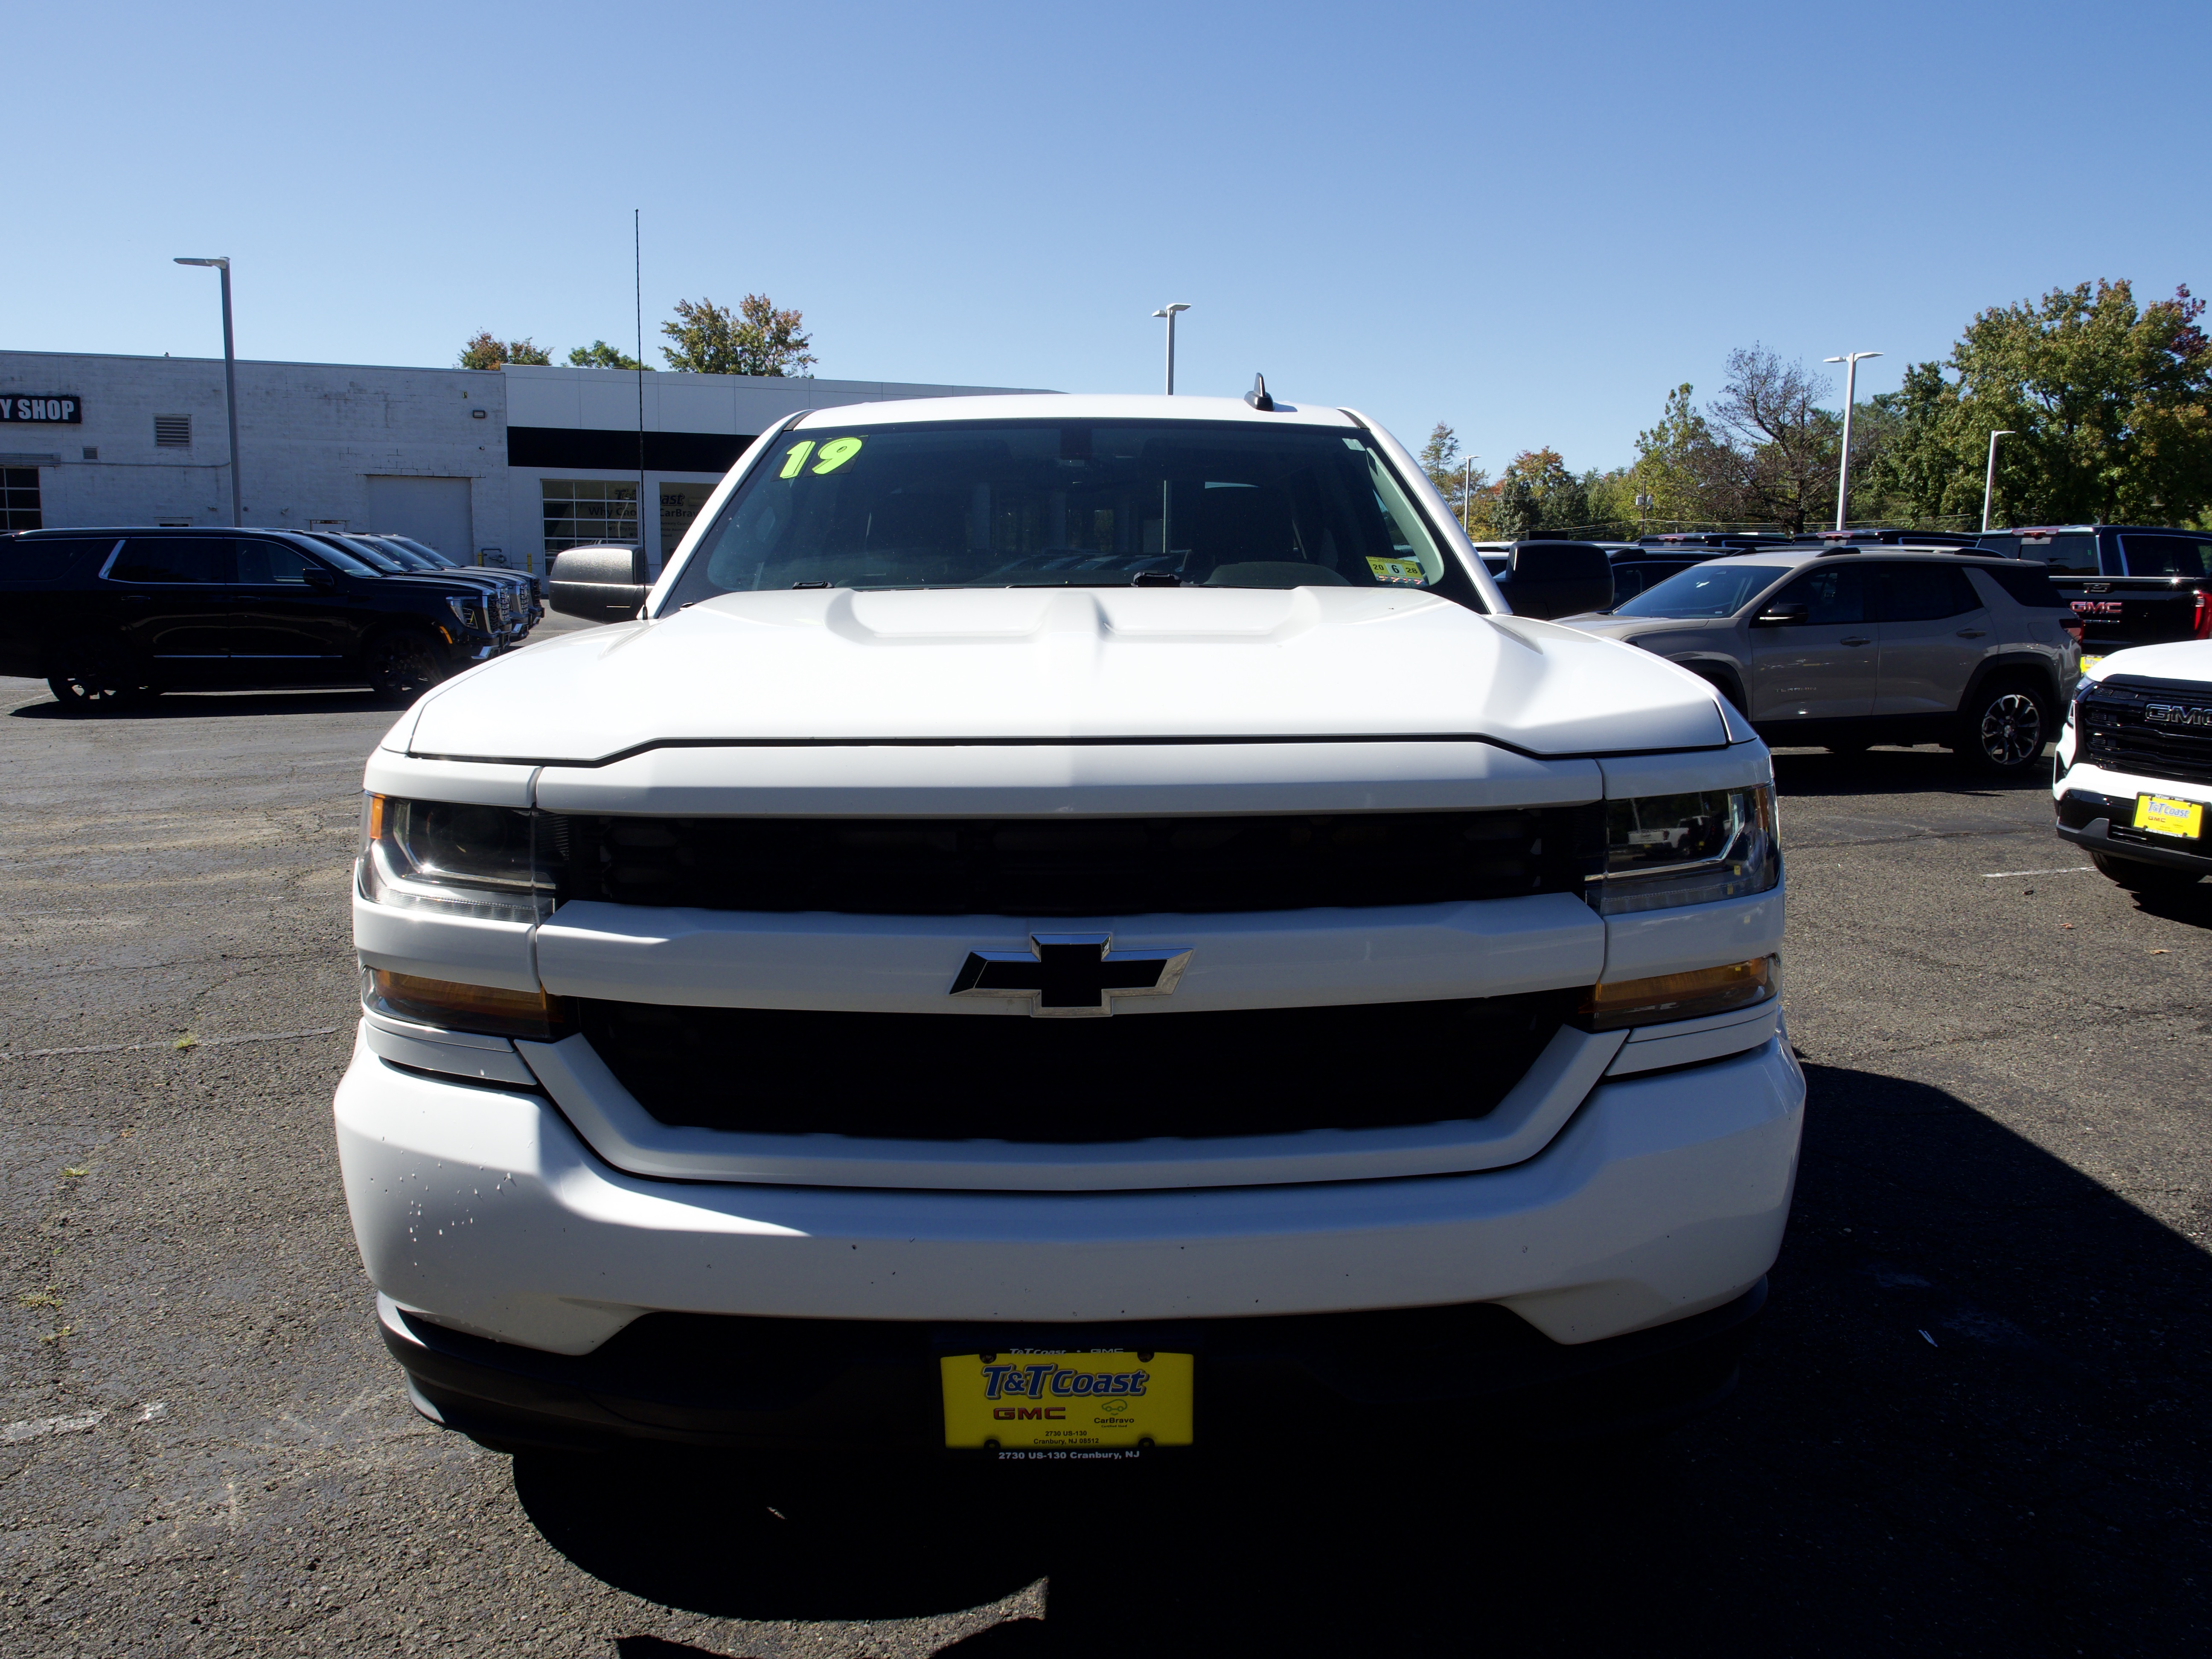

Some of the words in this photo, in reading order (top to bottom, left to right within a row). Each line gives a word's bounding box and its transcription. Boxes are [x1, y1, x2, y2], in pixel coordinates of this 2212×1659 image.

[17, 399, 74, 420] SHOP
[780, 437, 862, 479] 19
[588, 507, 612, 518] Why
[1391, 565, 1400, 573] 6
[2070, 601, 2123, 614] GMC
[2148, 801, 2165, 814] T&T
[2164, 806, 2190, 818] Coast
[983, 1363, 1058, 1400] T&T
[1050, 1370, 1149, 1397] Coast
[993, 1407, 1066, 1420] GMC
[1070, 1452, 1122, 1460] Cranbury,
